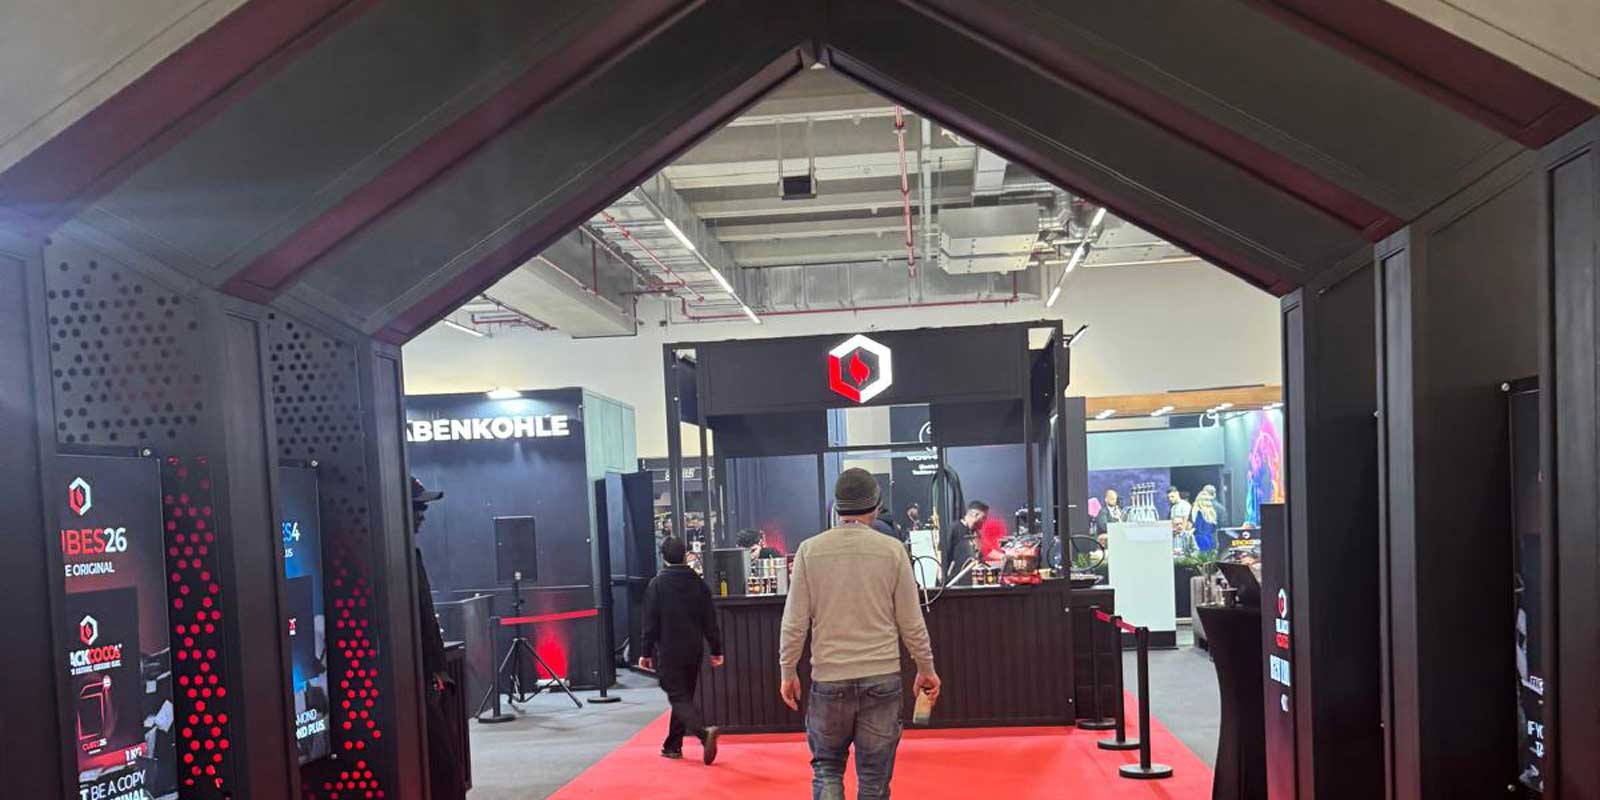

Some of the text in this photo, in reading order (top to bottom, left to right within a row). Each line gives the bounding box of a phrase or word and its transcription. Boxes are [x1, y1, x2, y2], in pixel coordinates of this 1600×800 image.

[72, 561, 115, 575] ORIGINAL
[90, 783, 107, 800] BE
[107, 780, 117, 796] A
[117, 769, 146, 792] COPY
